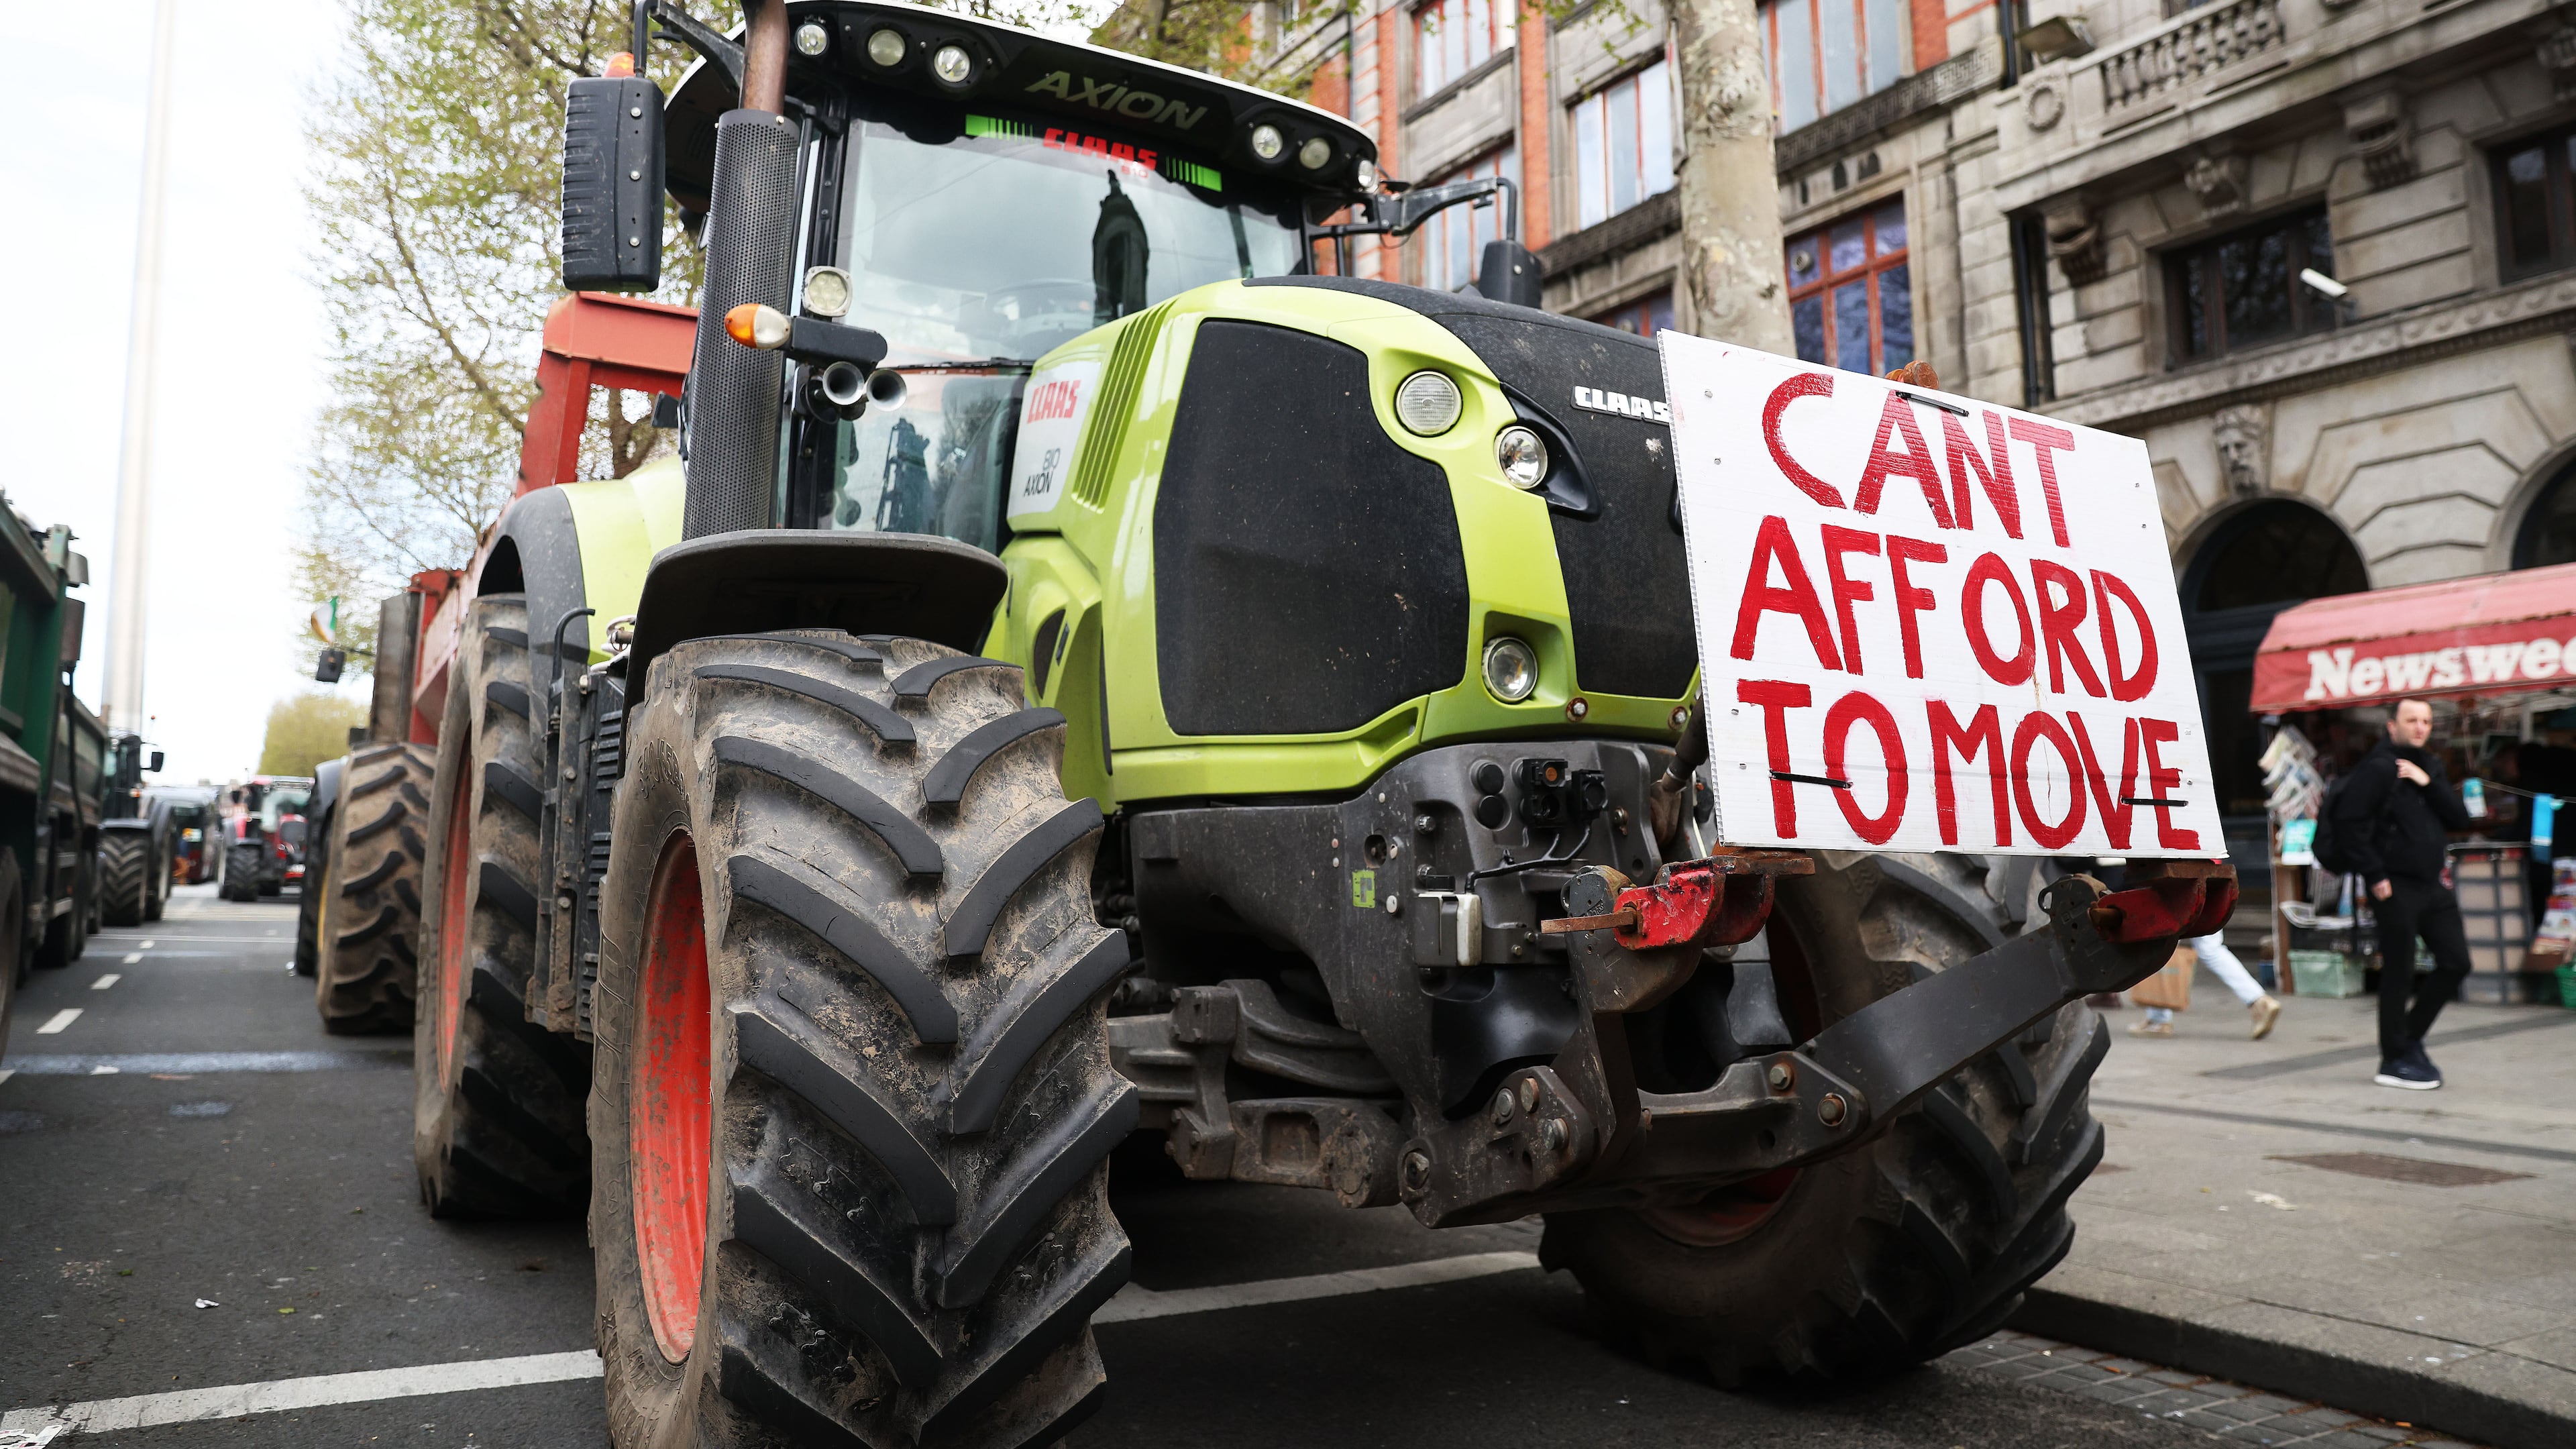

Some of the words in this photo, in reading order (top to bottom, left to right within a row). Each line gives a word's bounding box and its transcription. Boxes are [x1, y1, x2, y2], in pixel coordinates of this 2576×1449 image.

[1024, 70, 1208, 130] AXION
[1042, 127, 1159, 171] CLAAS
[1027, 380, 1082, 424] CLAAS
[1574, 385, 1670, 423] CLAAS
[1023, 471, 1055, 498] AXION
[1762, 372, 2076, 548] CANT
[1730, 515, 2159, 702] AFFORD
[1737, 679, 1908, 846] TO
[1925, 699, 2202, 850] MOVE
